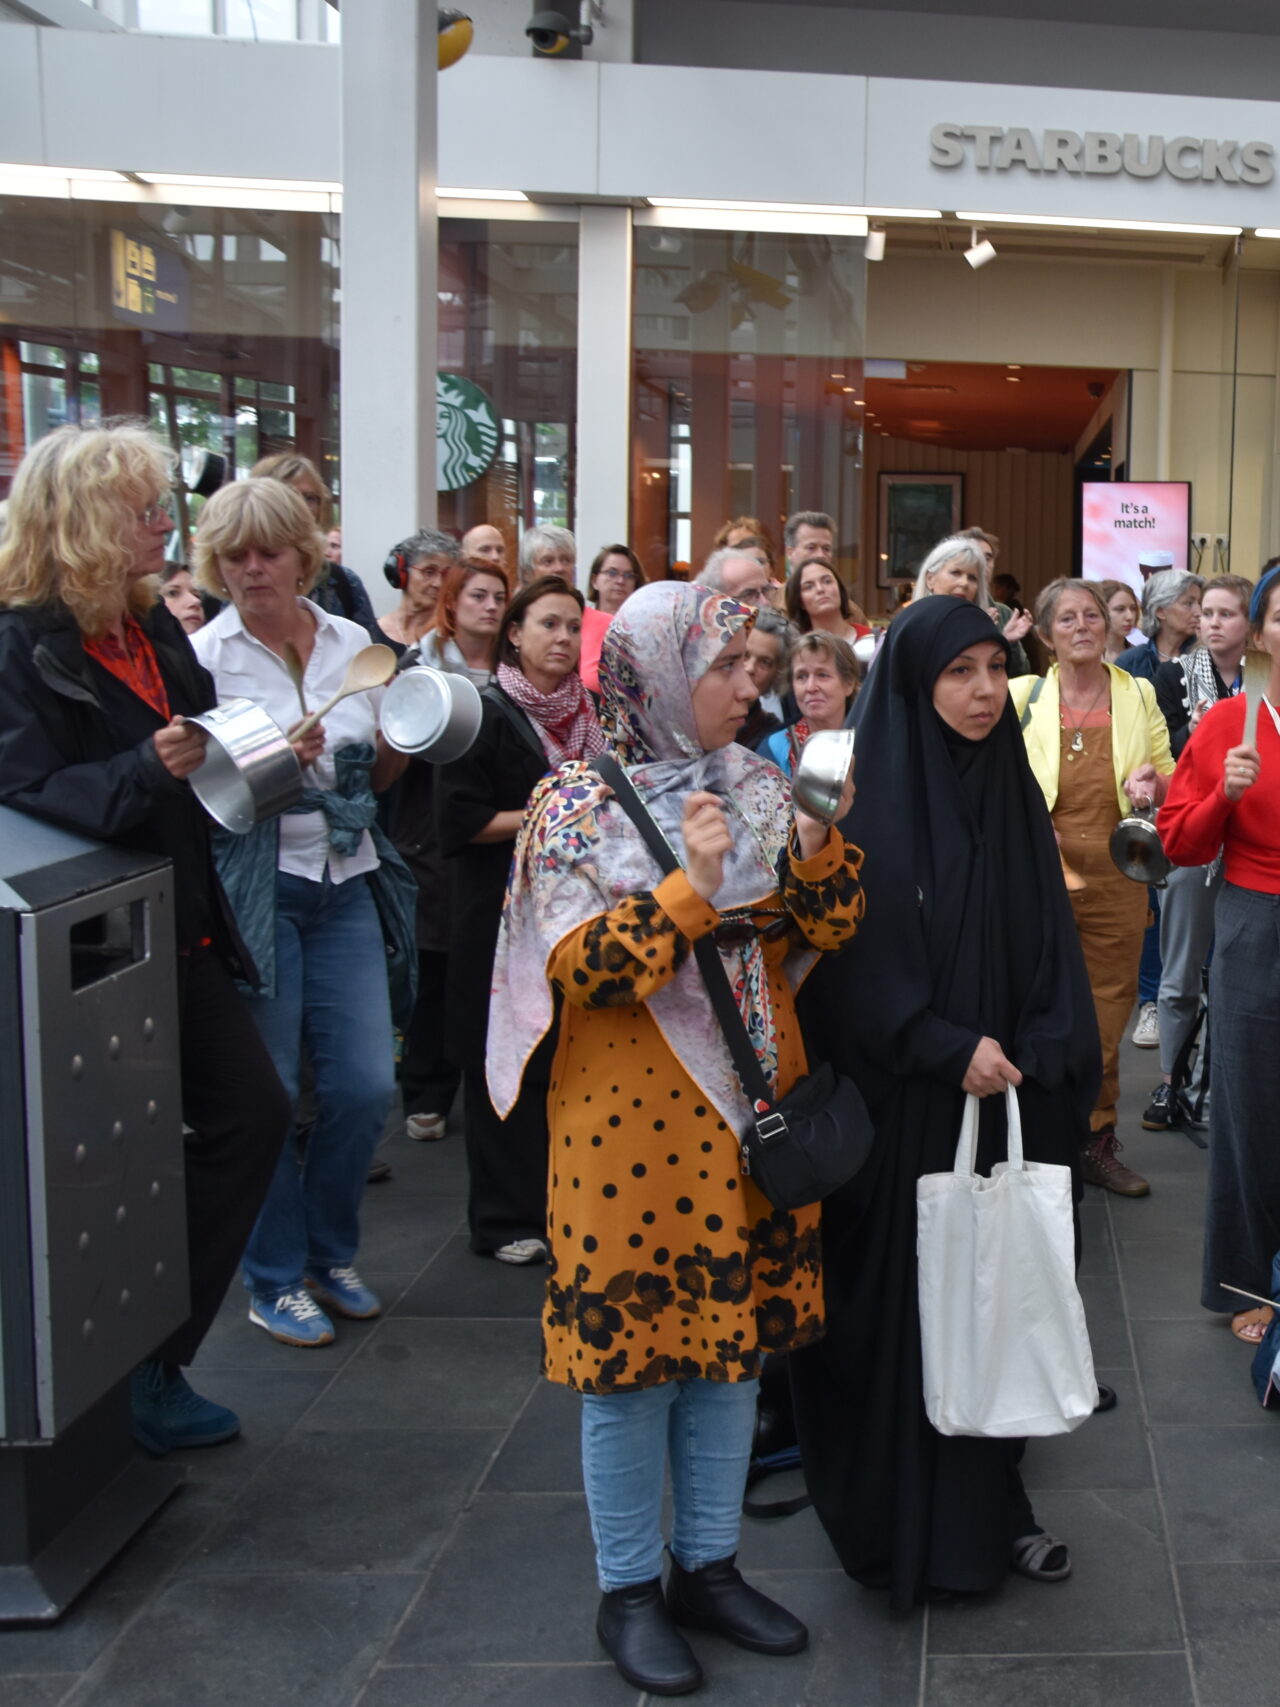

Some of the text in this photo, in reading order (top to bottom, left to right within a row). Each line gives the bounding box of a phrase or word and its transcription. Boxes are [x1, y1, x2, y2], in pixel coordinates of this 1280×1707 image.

[929, 122, 1275, 184] STARBUCKS
[1121, 502, 1149, 514] It's a
[1114, 517, 1155, 529] match!
